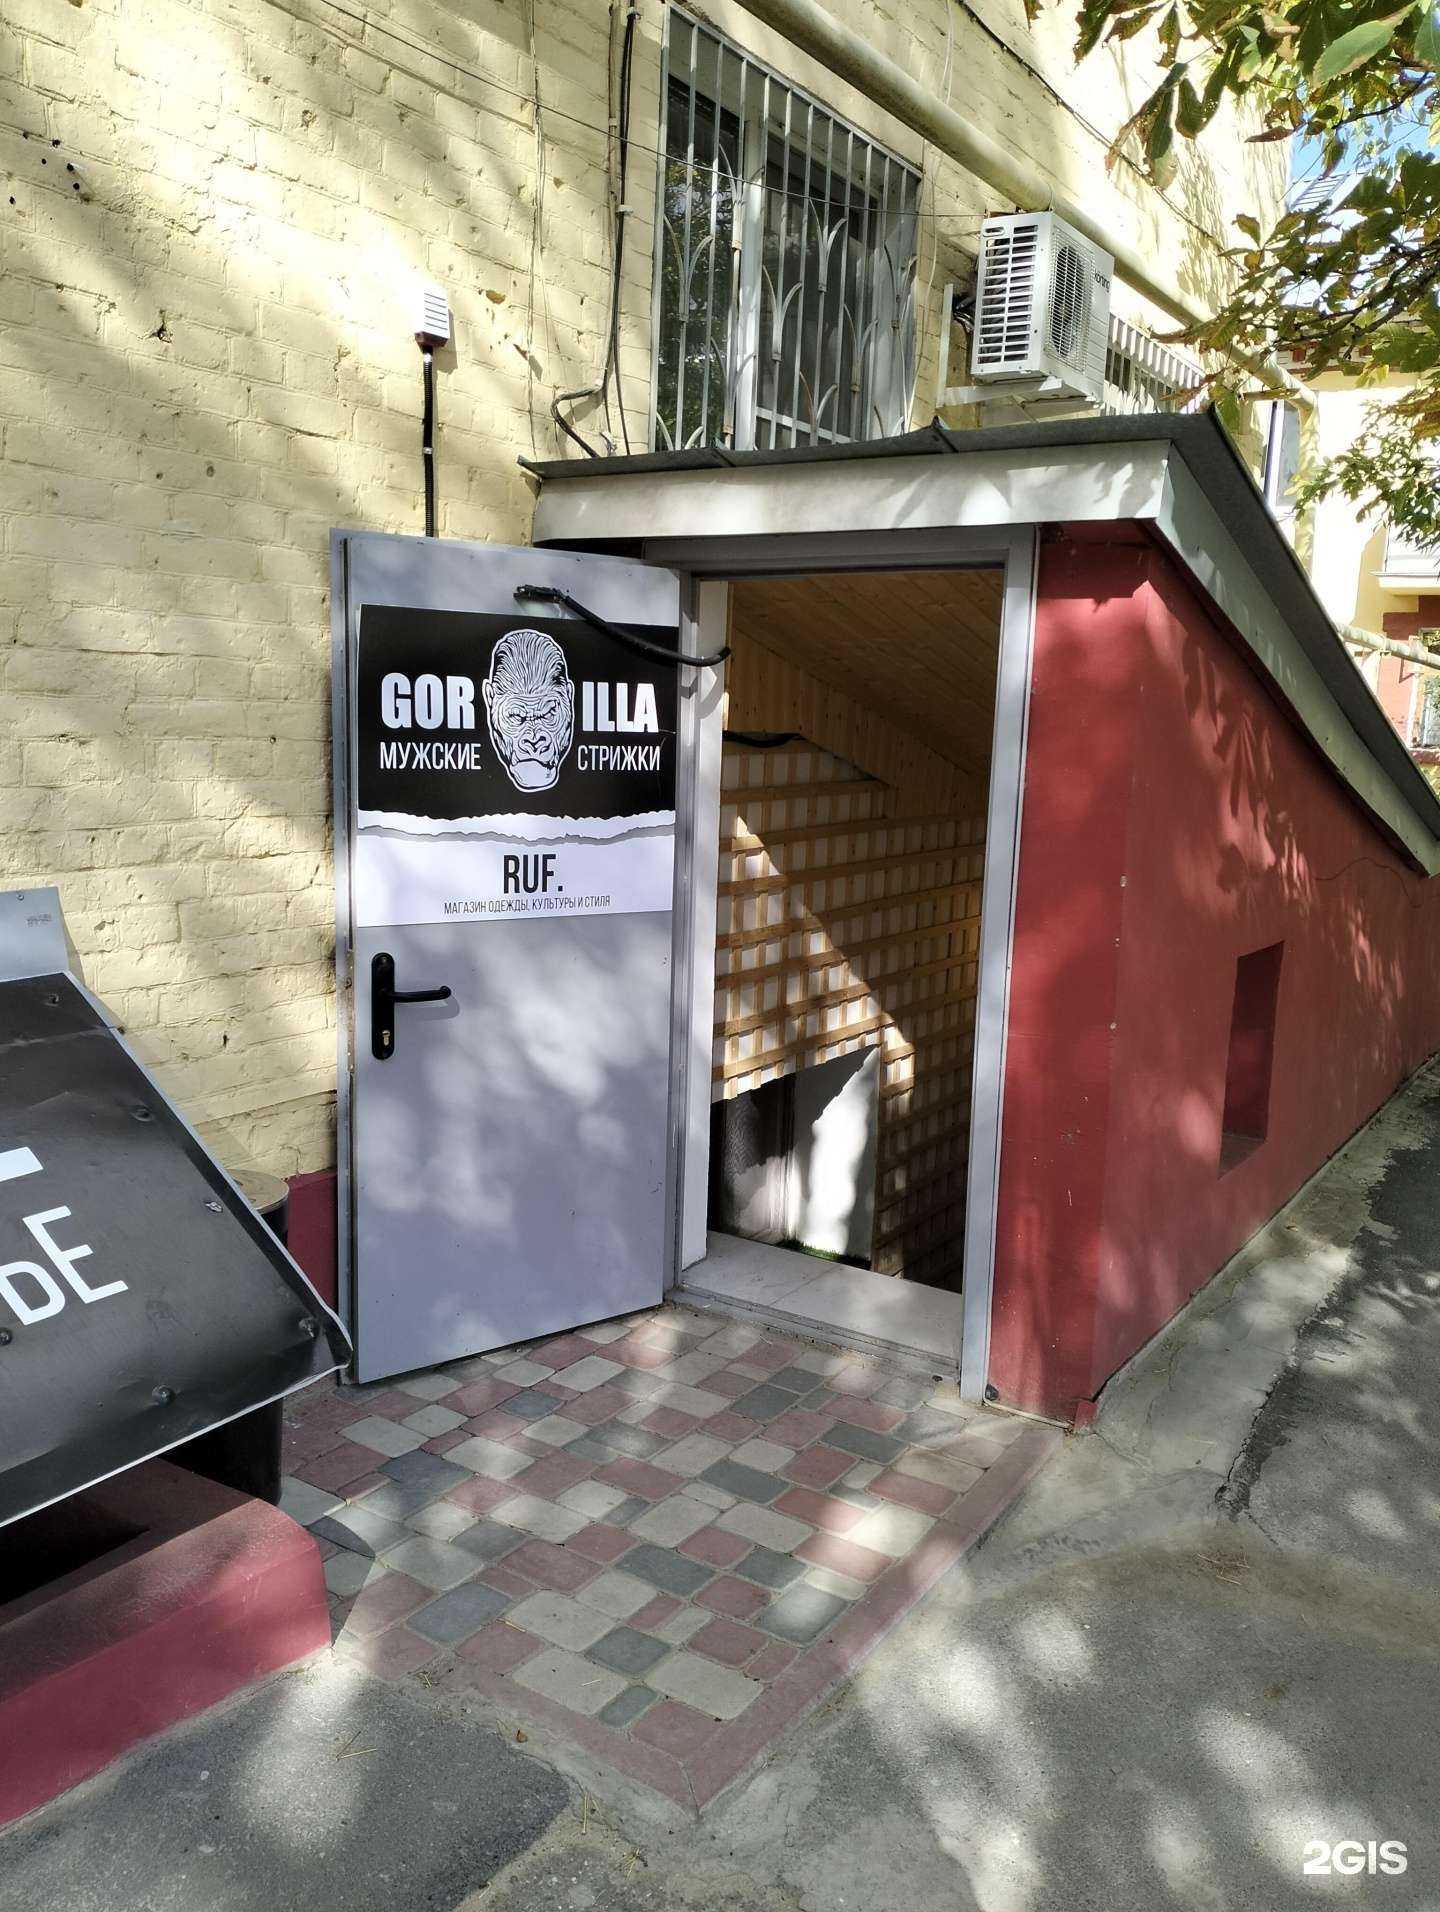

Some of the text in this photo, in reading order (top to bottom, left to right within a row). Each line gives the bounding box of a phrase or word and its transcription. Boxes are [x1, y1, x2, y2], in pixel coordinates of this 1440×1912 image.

[381, 672, 660, 732] GOR ILLA
[379, 741, 661, 771] МУЖСКИЕ СТРИЖКИ
[503, 854, 564, 894] RUF.
[444, 895, 611, 915] МАГАЗИН ОДЕЖДЫ, КУЛЬТУРЫ И СТИЛЯ
